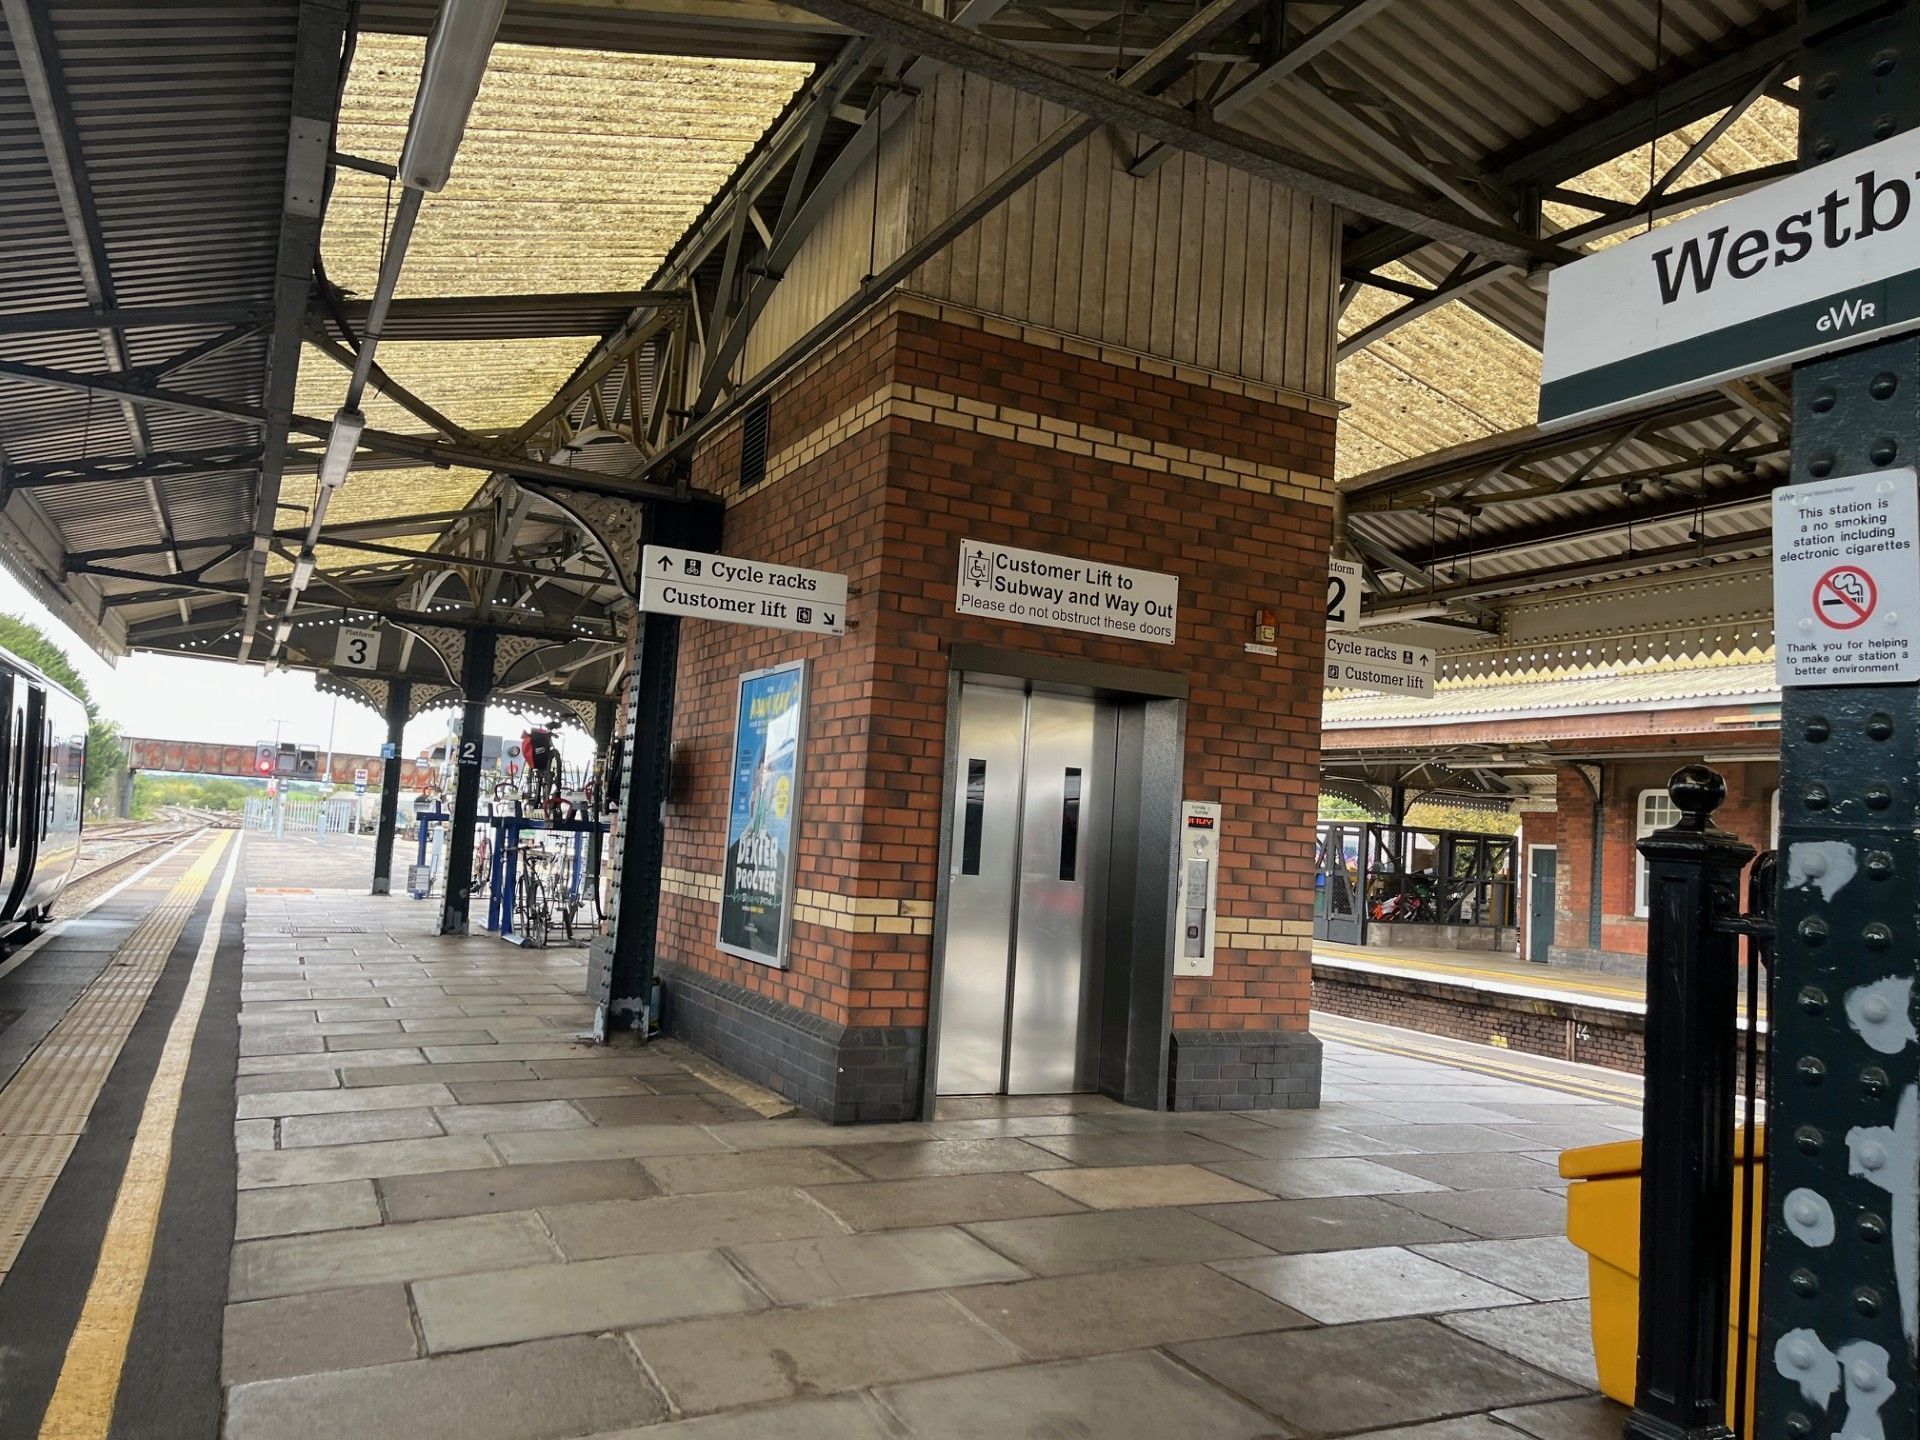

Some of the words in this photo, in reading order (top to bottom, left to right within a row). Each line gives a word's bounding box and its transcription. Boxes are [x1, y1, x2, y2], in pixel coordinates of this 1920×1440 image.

[1651, 170, 1920, 305] Westb
[1815, 299, 1876, 332] GWR
[1799, 508, 1823, 521] This
[1829, 502, 1872, 516] station
[1878, 499, 1889, 509] is
[1800, 524, 1807, 533] a
[1813, 522, 1828, 531] no
[1835, 513, 1888, 529] smoking
[1793, 534, 1835, 547] station
[1840, 526, 1896, 542] including
[1780, 546, 1839, 562] electronic
[1845, 539, 1911, 556] cigarettes
[711, 561, 764, 583] Cycle
[768, 572, 817, 591] racks
[995, 553, 1081, 582] Customer
[1086, 568, 1112, 588] Lift
[1117, 574, 1133, 590] to
[662, 586, 756, 614] Customer
[761, 601, 788, 619] lift
[994, 576, 1064, 604] Subway
[1069, 590, 1100, 607] and
[1105, 593, 1139, 617] Way
[1144, 600, 1173, 619] Out
[1327, 576, 1346, 623] 2
[961, 593, 1005, 612] Please
[1009, 601, 1025, 615] do
[1029, 605, 1049, 619] not
[1052, 609, 1101, 627] obstruct
[1104, 617, 1136, 632] these
[1140, 622, 1172, 638] doors
[347, 639, 367, 664] 3
[1327, 638, 1362, 655] Cycle
[1365, 646, 1397, 660] racks
[1786, 642, 1817, 652] Thank
[1823, 641, 1842, 652] you
[1847, 640, 1863, 649] for
[1868, 638, 1908, 649] helping
[1786, 655, 1797, 664] to
[1801, 653, 1830, 664] make
[1835, 653, 1852, 662] our
[1858, 651, 1896, 661] station
[1902, 651, 1909, 659] a
[1345, 666, 1405, 686] Customer
[1407, 675, 1424, 689] lift
[1795, 666, 1827, 675] better
[1832, 663, 1899, 675] environment
[463, 742, 476, 758] 2
[737, 835, 778, 869] DEXTER
[735, 866, 777, 896] PROCTER
